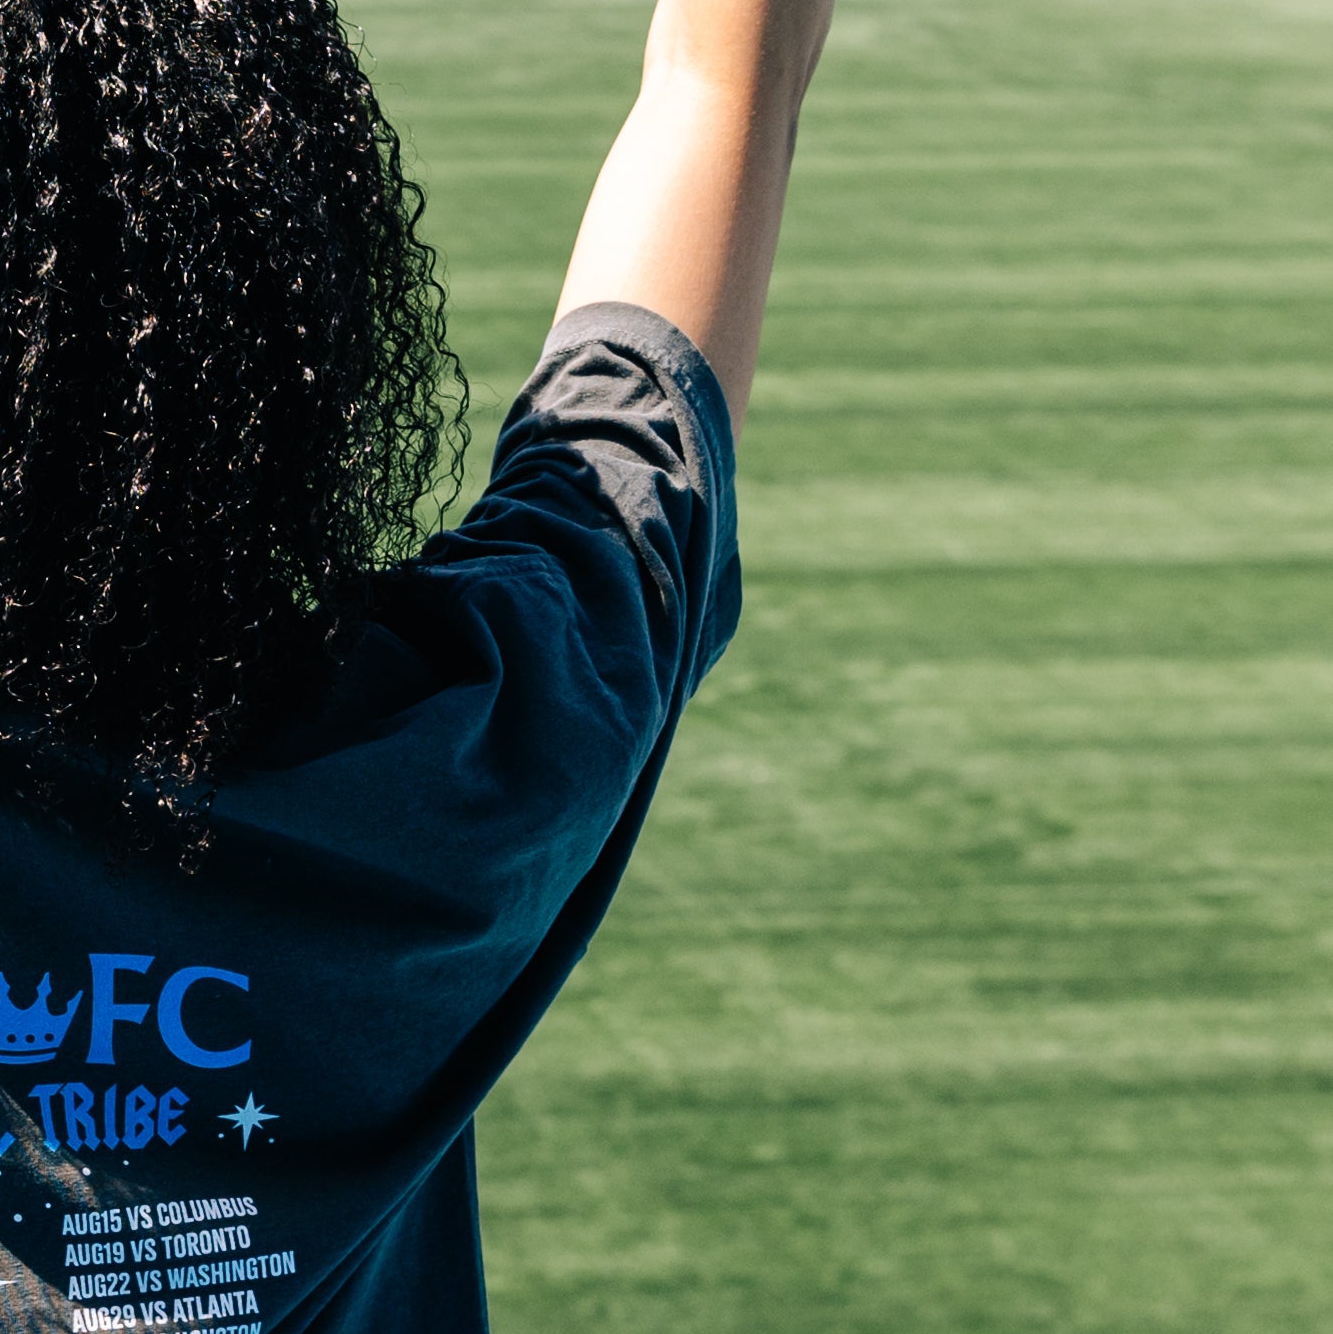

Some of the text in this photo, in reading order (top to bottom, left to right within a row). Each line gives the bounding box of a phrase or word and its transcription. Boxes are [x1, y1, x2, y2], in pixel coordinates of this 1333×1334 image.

[87, 953, 251, 1068] FC
[28, 1081, 190, 1153] TRIBE
[62, 1197, 258, 1236] AUG15 VS COLUMBUS
[65, 1225, 251, 1267] AUG19 VS TORONTO
[68, 1250, 296, 1301] AUG22 VS WASHINGTON
[72, 1289, 259, 1333] AUG29 VS ATLANTA
